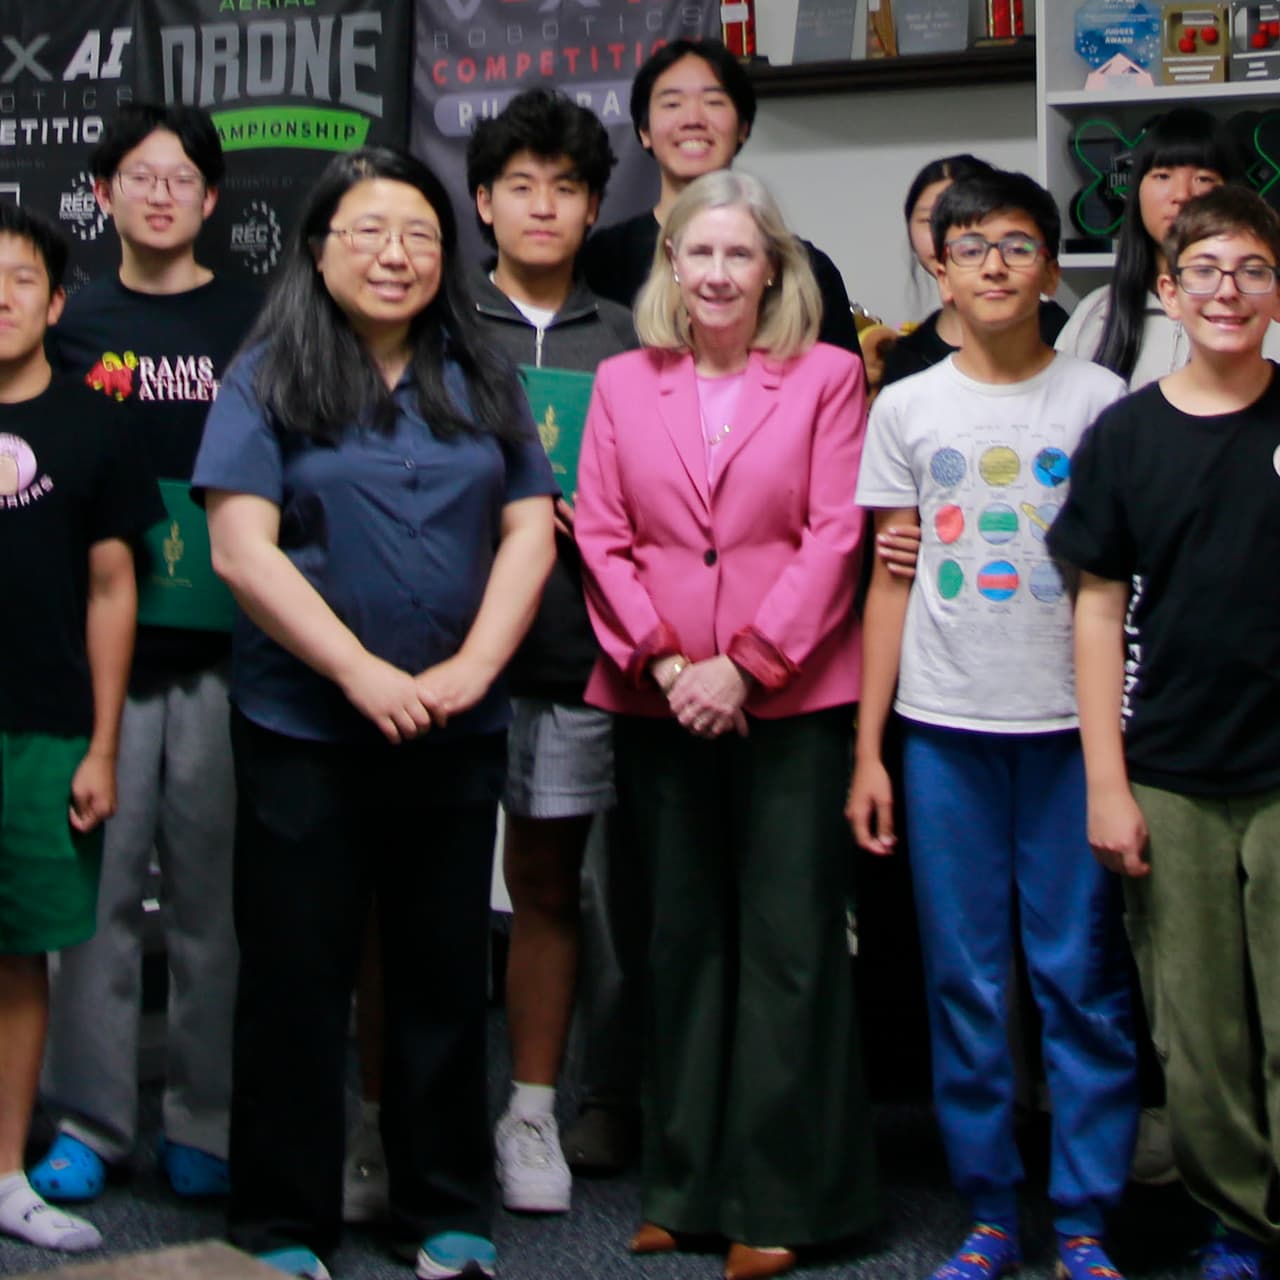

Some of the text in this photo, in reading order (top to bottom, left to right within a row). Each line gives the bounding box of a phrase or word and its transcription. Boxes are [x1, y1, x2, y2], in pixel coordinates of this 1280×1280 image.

[433, 7, 702, 49] ROBOTICS
[62, 26, 133, 81] AI
[160, 10, 384, 119] DRONE
[432, 38, 667, 87] COMPETITI
[218, 120, 357, 144] AMPIONSHIP
[138, 377, 220, 402] ATHLET
[139, 355, 214, 383] RAMS
